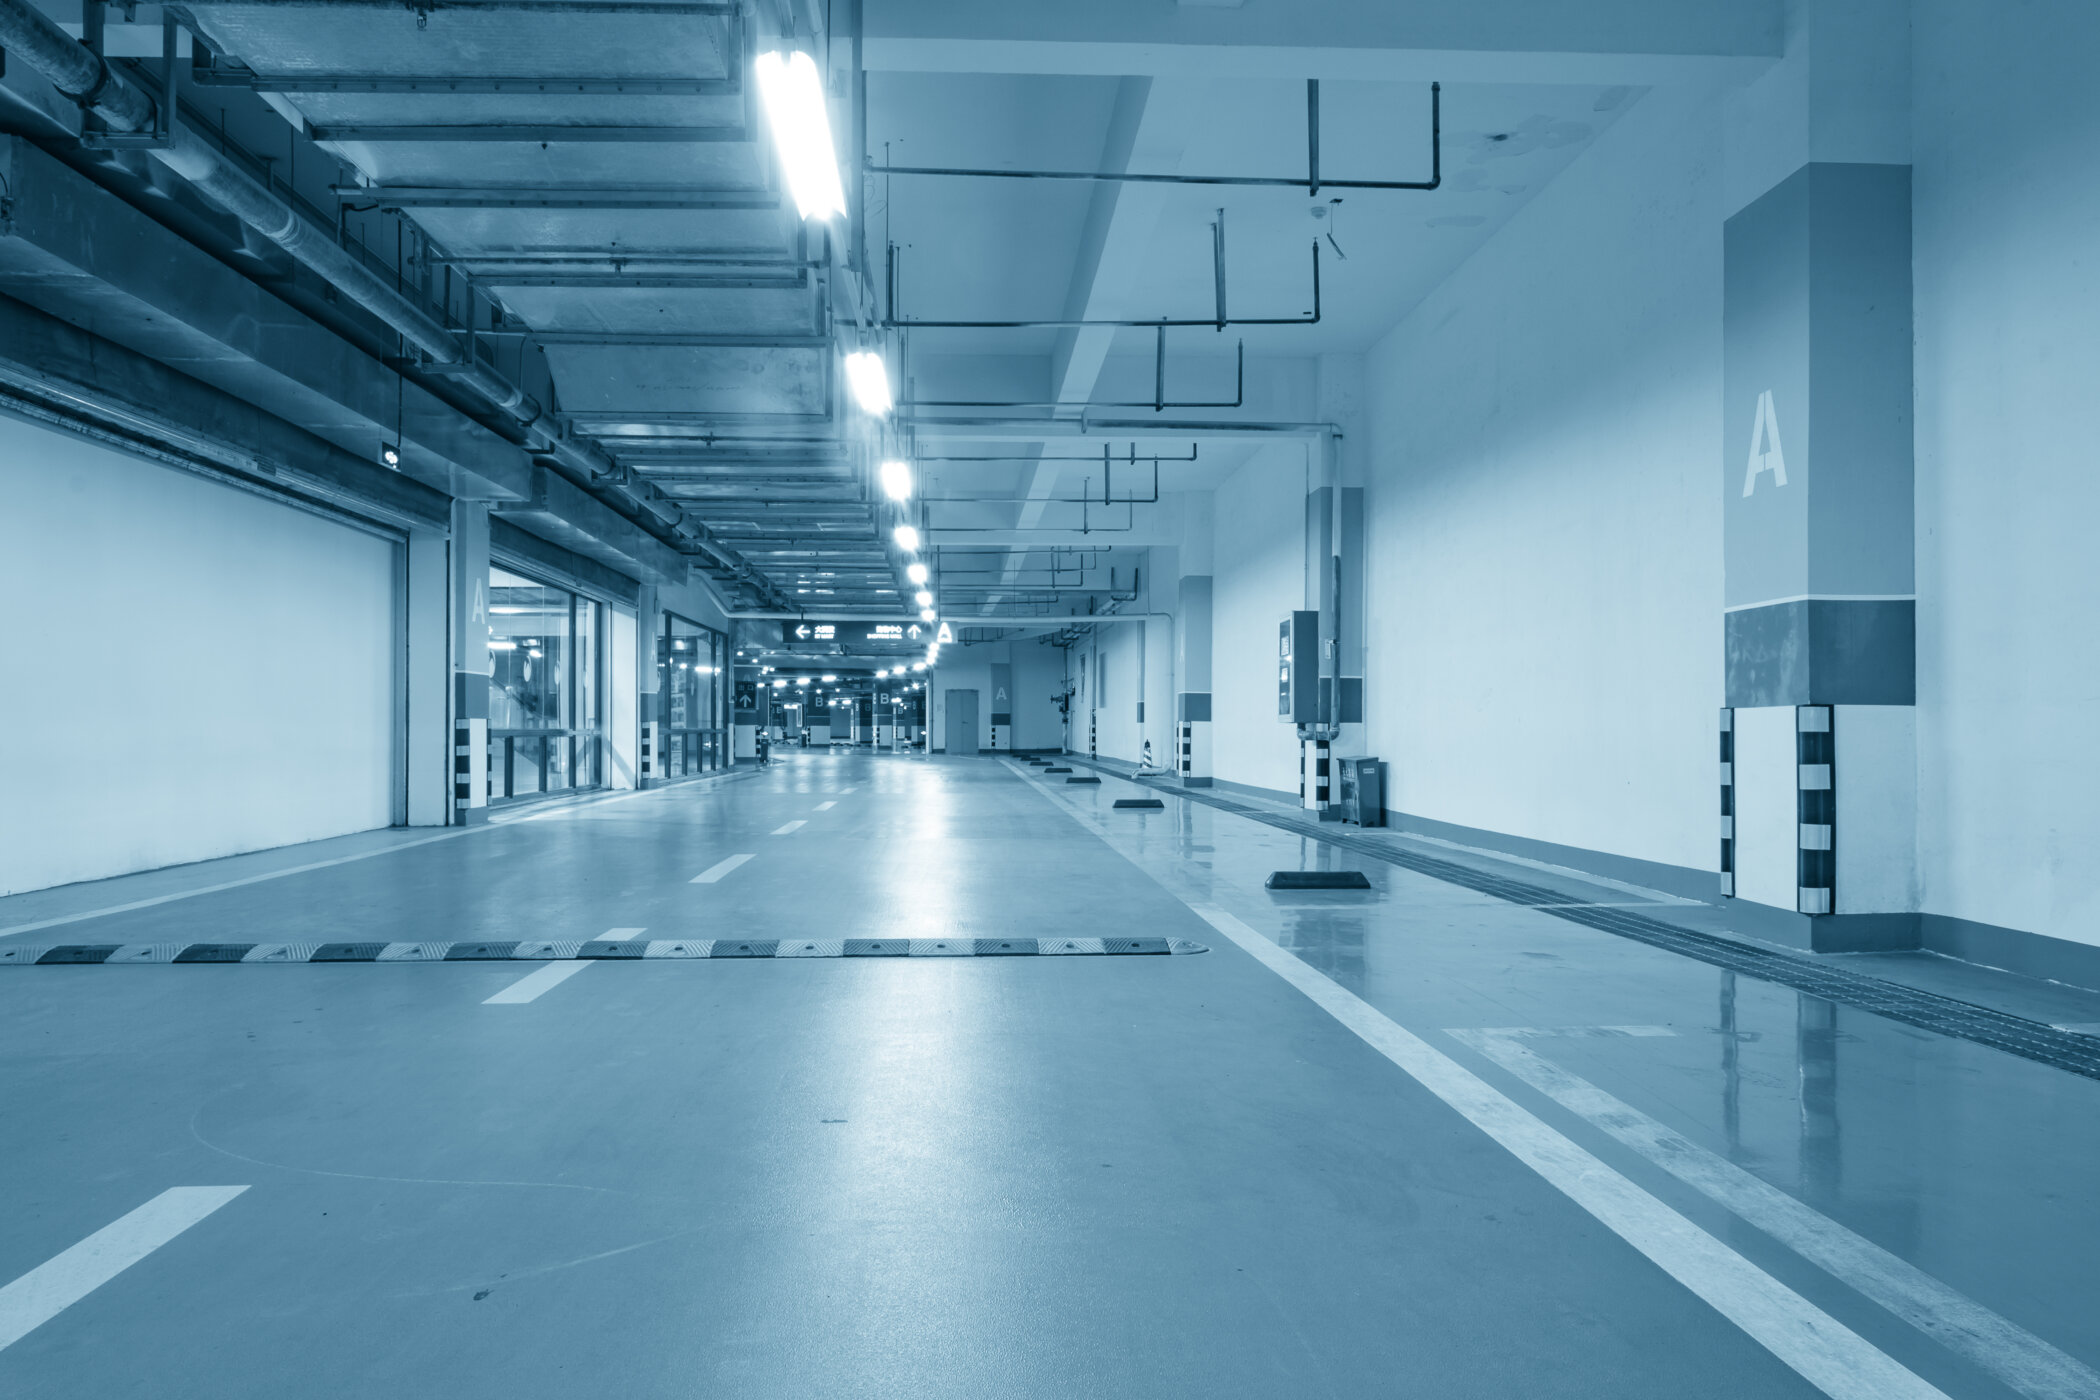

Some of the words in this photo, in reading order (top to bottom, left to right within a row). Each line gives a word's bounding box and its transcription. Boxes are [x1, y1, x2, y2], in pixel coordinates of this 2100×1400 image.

[1742, 389, 1788, 498] A
[472, 578, 485, 624] A
[938, 622, 952, 643] A
[815, 697, 823, 707] B
[880, 693, 889, 704] B
[996, 687, 1007, 700] A
